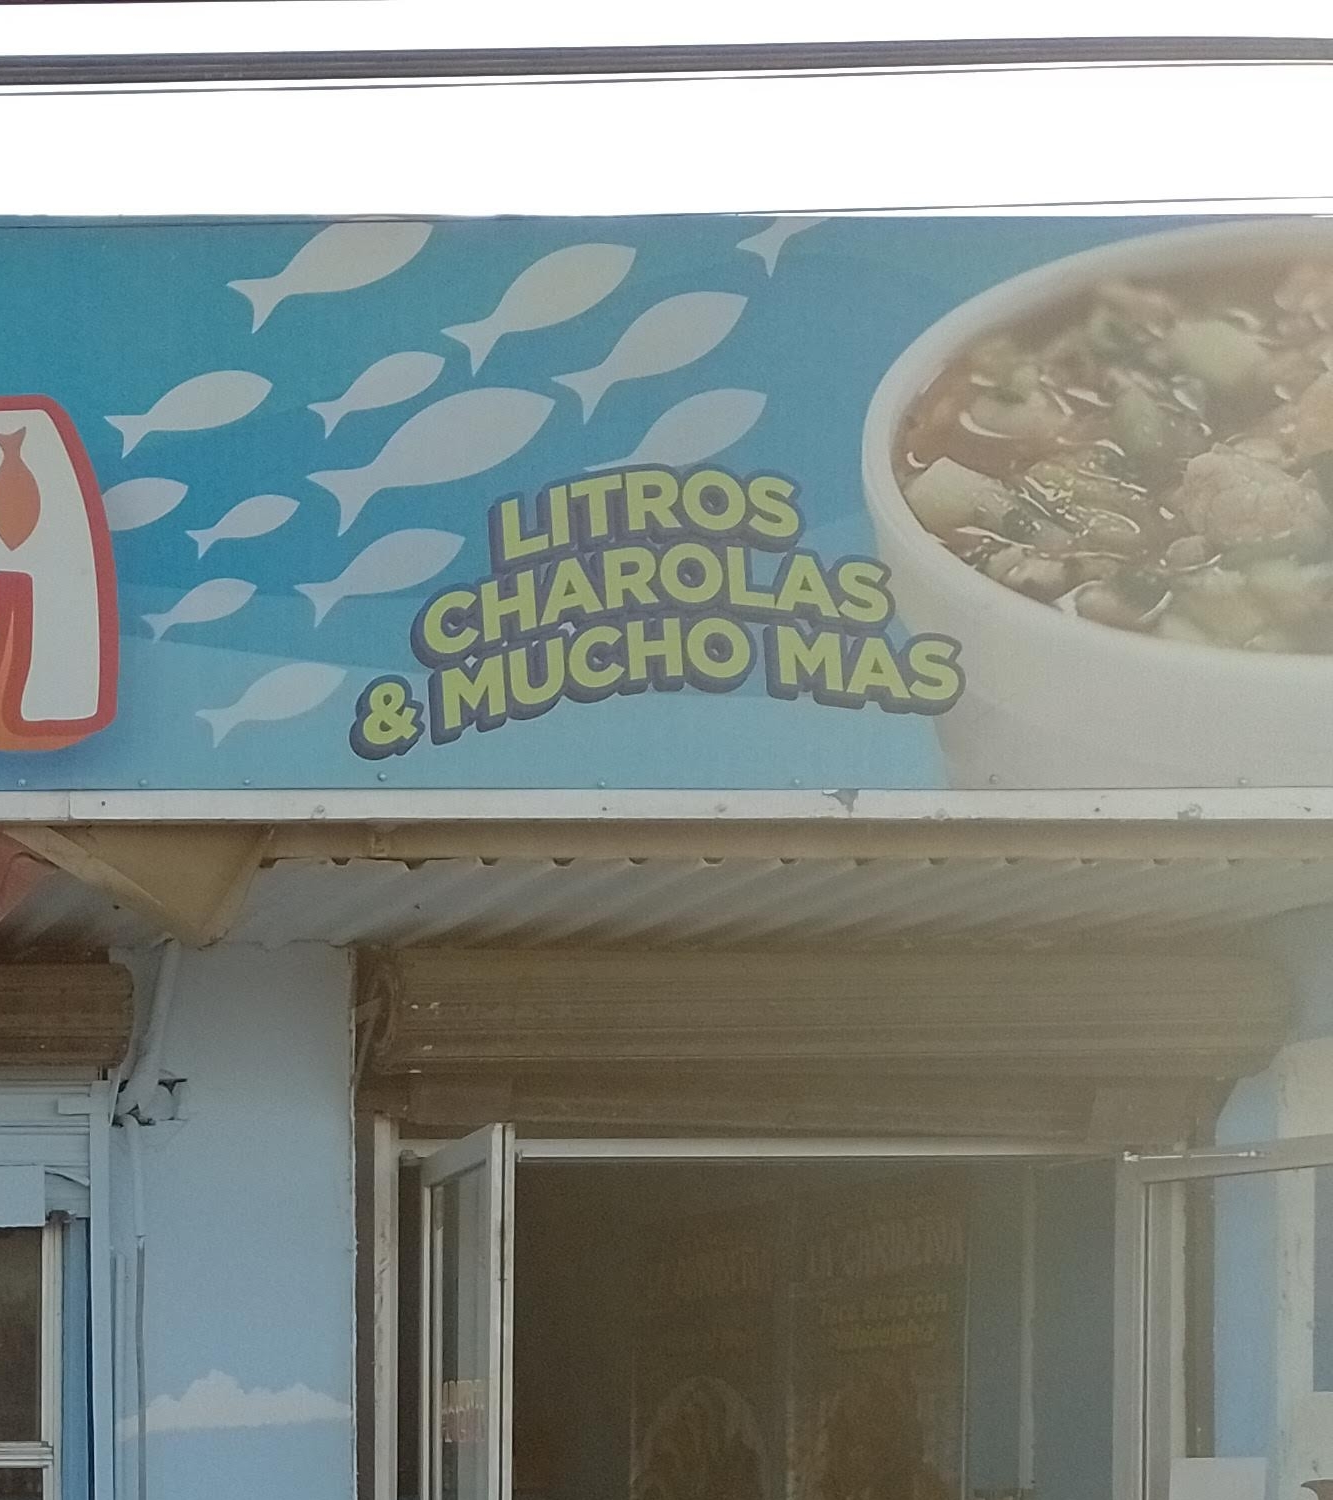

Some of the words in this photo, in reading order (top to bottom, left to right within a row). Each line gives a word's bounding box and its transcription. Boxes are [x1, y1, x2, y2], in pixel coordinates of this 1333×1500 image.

[499, 469, 800, 562] LITROS
[422, 542, 891, 655] CHAROLAS
[361, 682, 419, 747] &
[437, 617, 751, 731] MUCHO
[775, 624, 960, 701] MAS
